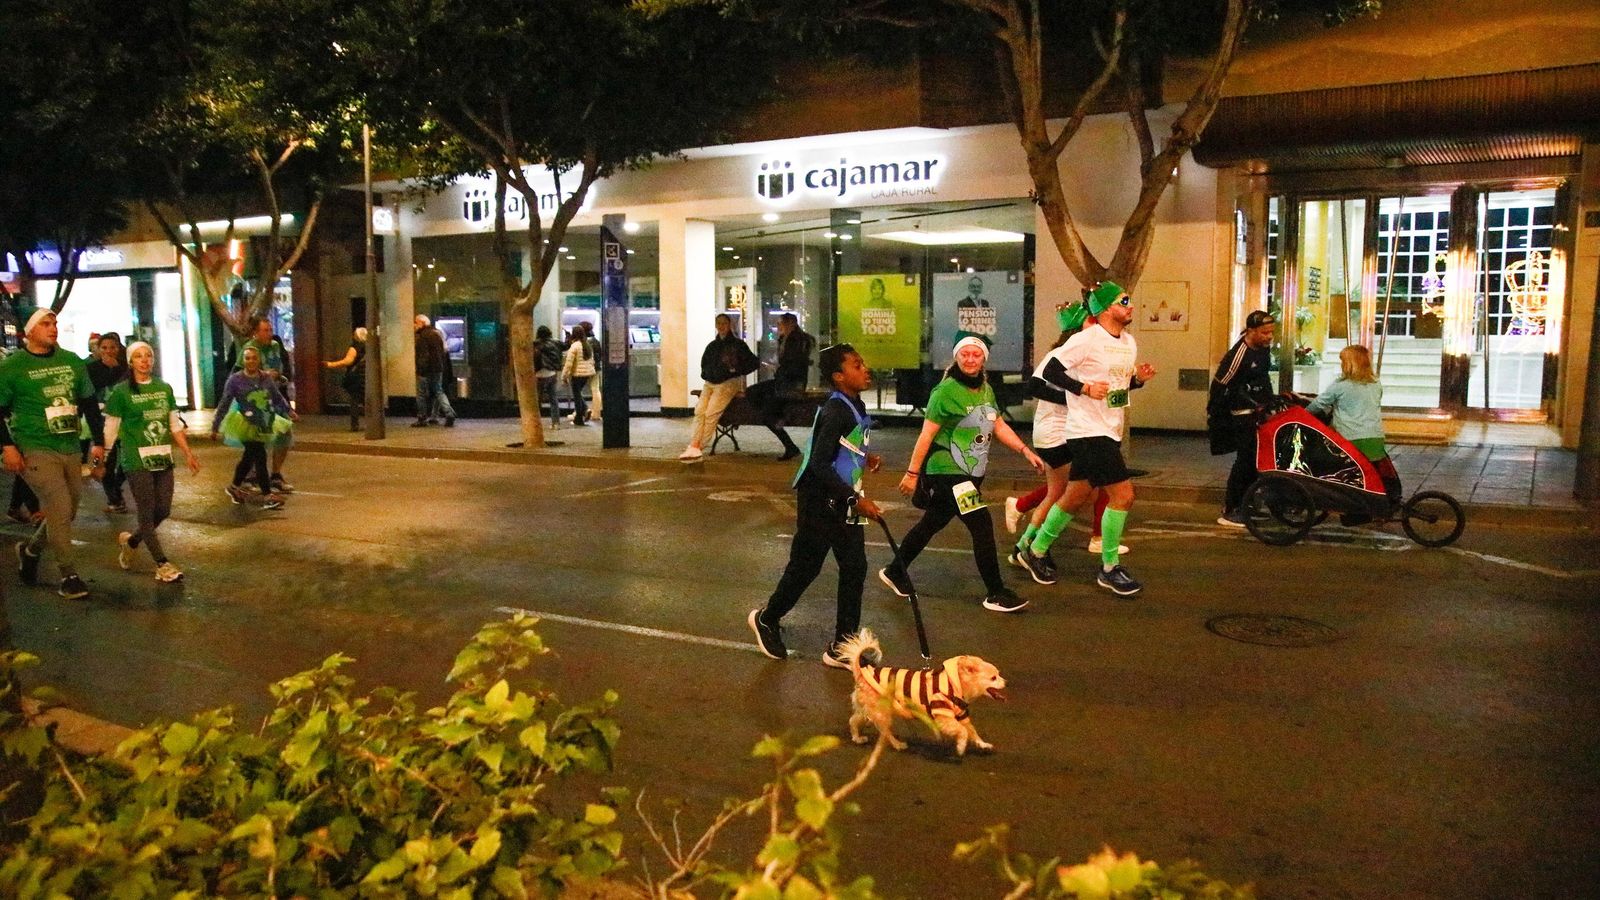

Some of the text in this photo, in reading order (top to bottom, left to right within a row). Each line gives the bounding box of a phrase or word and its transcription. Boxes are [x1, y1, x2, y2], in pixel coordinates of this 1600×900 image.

[805, 158, 938, 197] cajamar
[871, 186, 938, 199] CAJA RURAL
[861, 324, 897, 335] TODO
